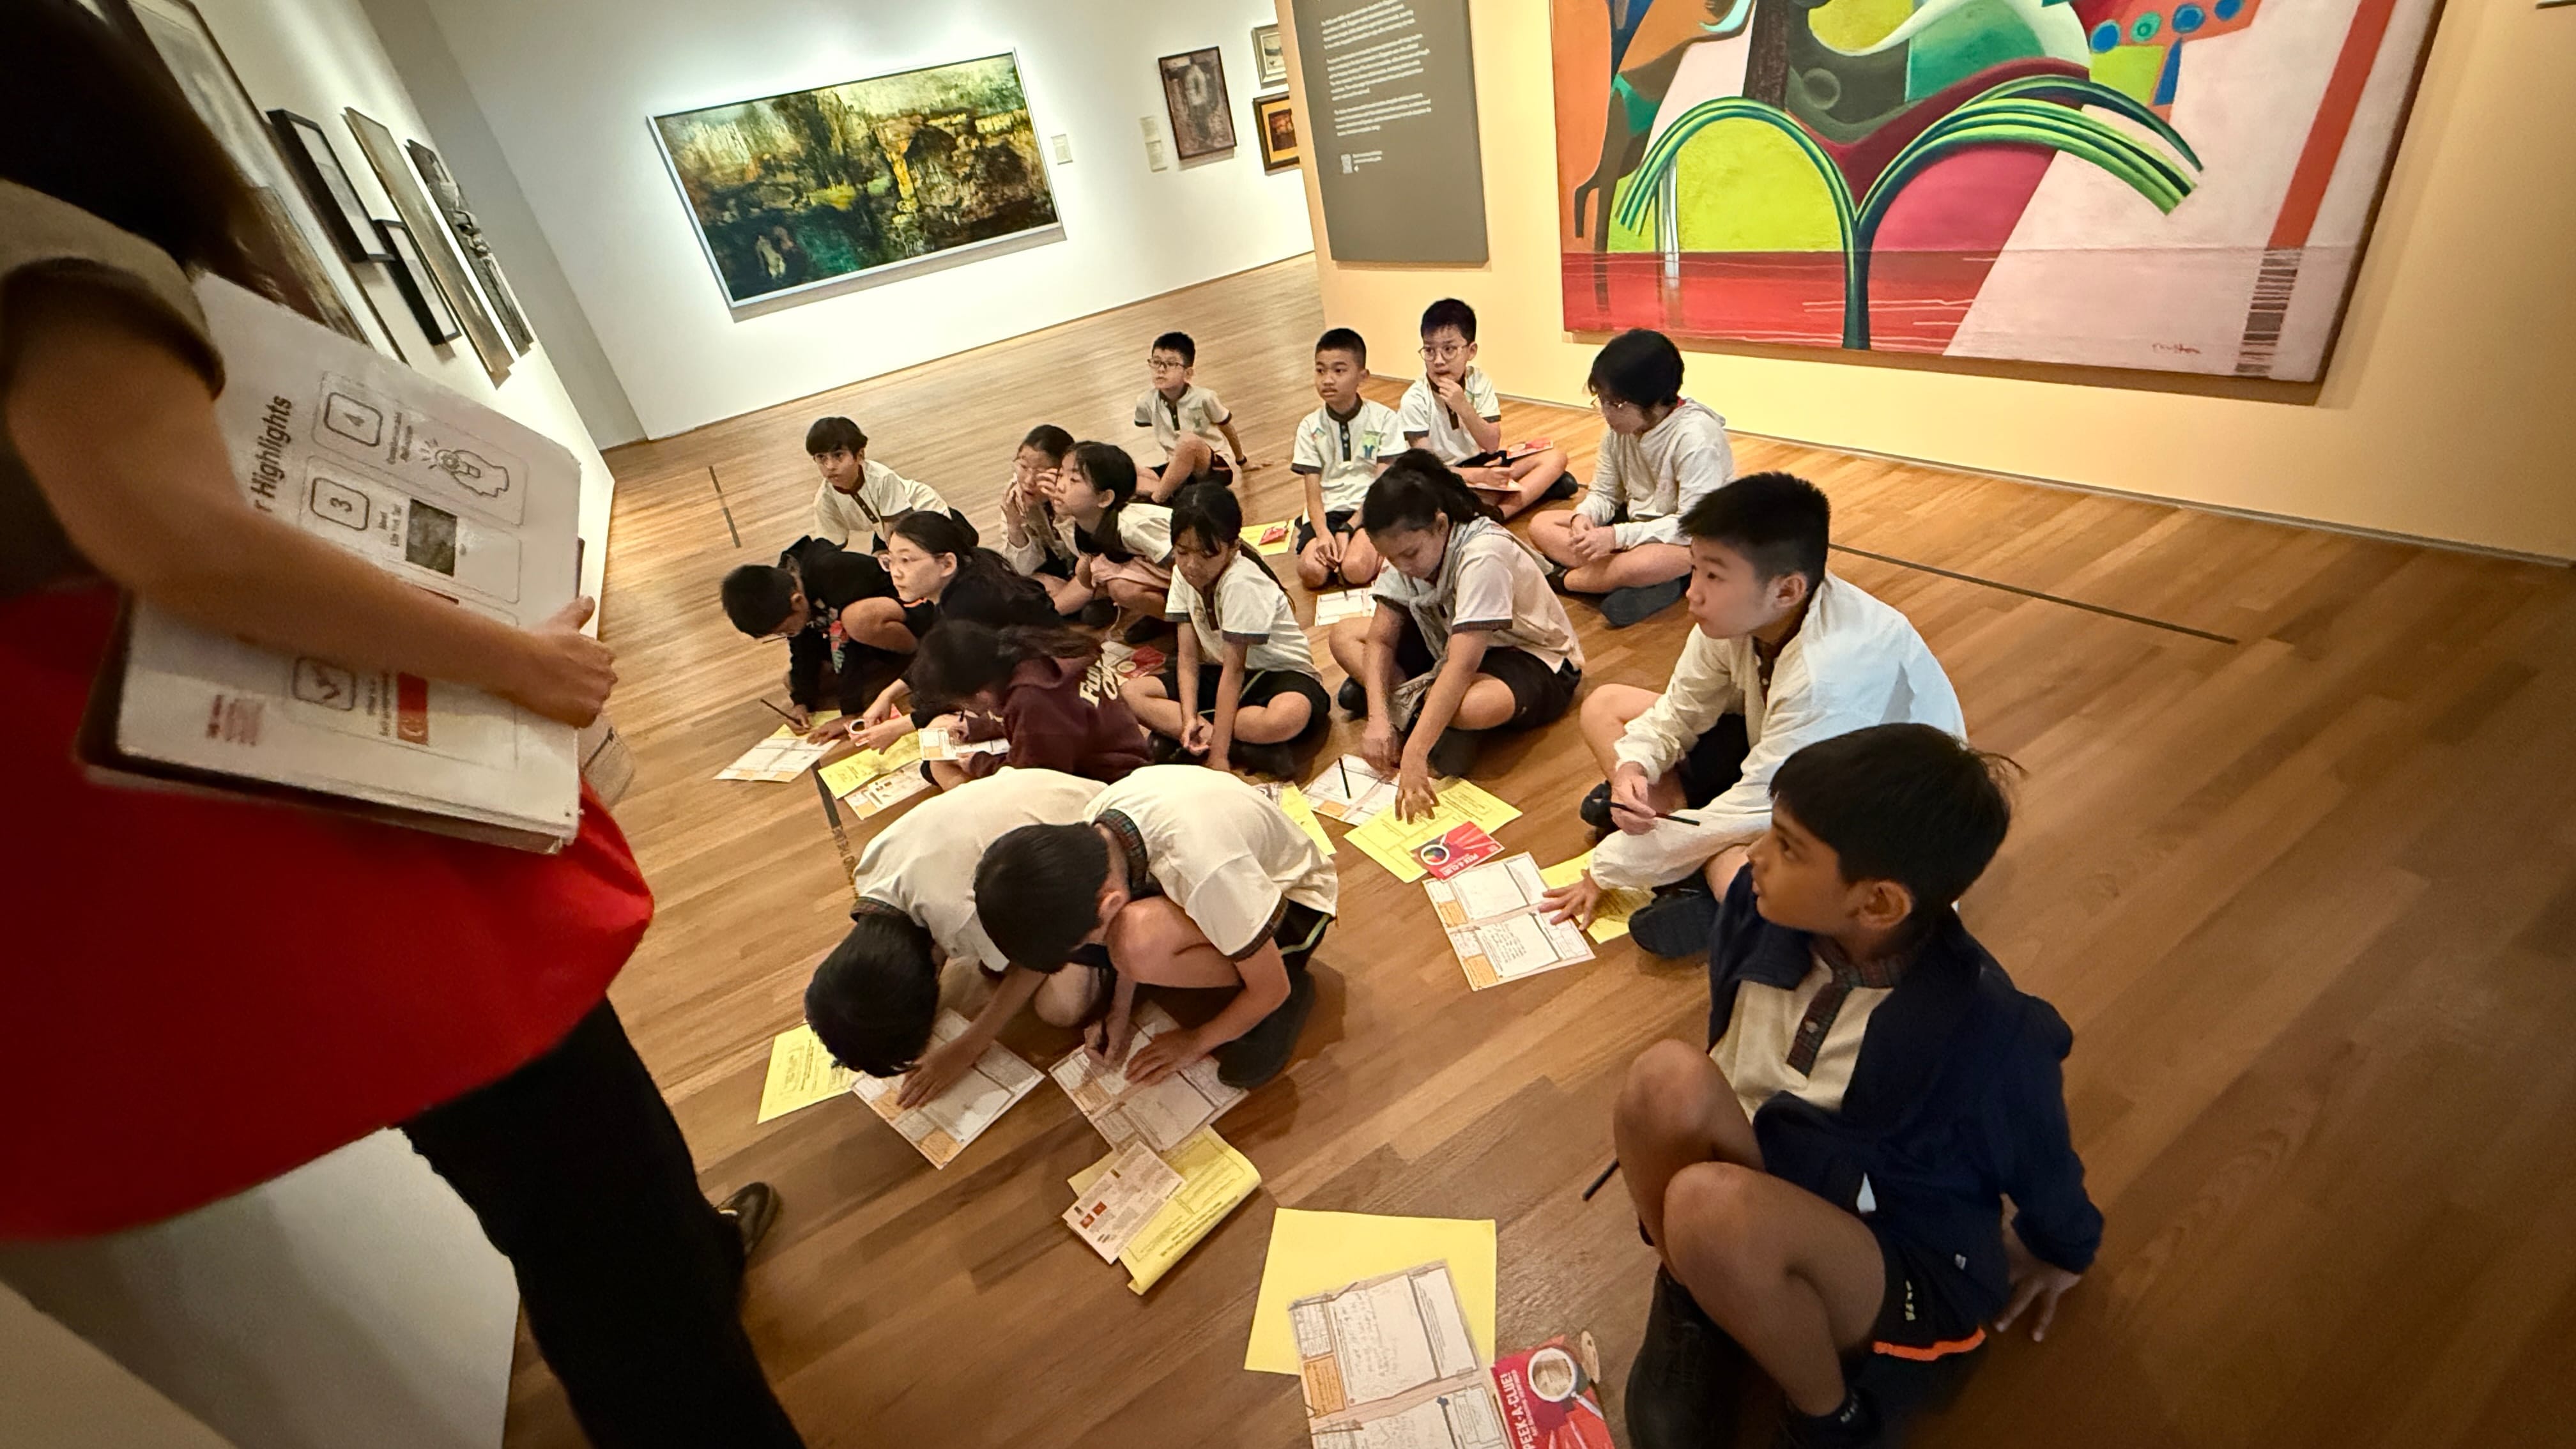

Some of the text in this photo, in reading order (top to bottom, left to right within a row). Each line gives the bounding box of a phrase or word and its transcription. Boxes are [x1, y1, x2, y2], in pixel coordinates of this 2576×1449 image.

[342, 412, 365, 427] 4
[250, 395, 292, 500] Highlights
[329, 496, 353, 513] 3
